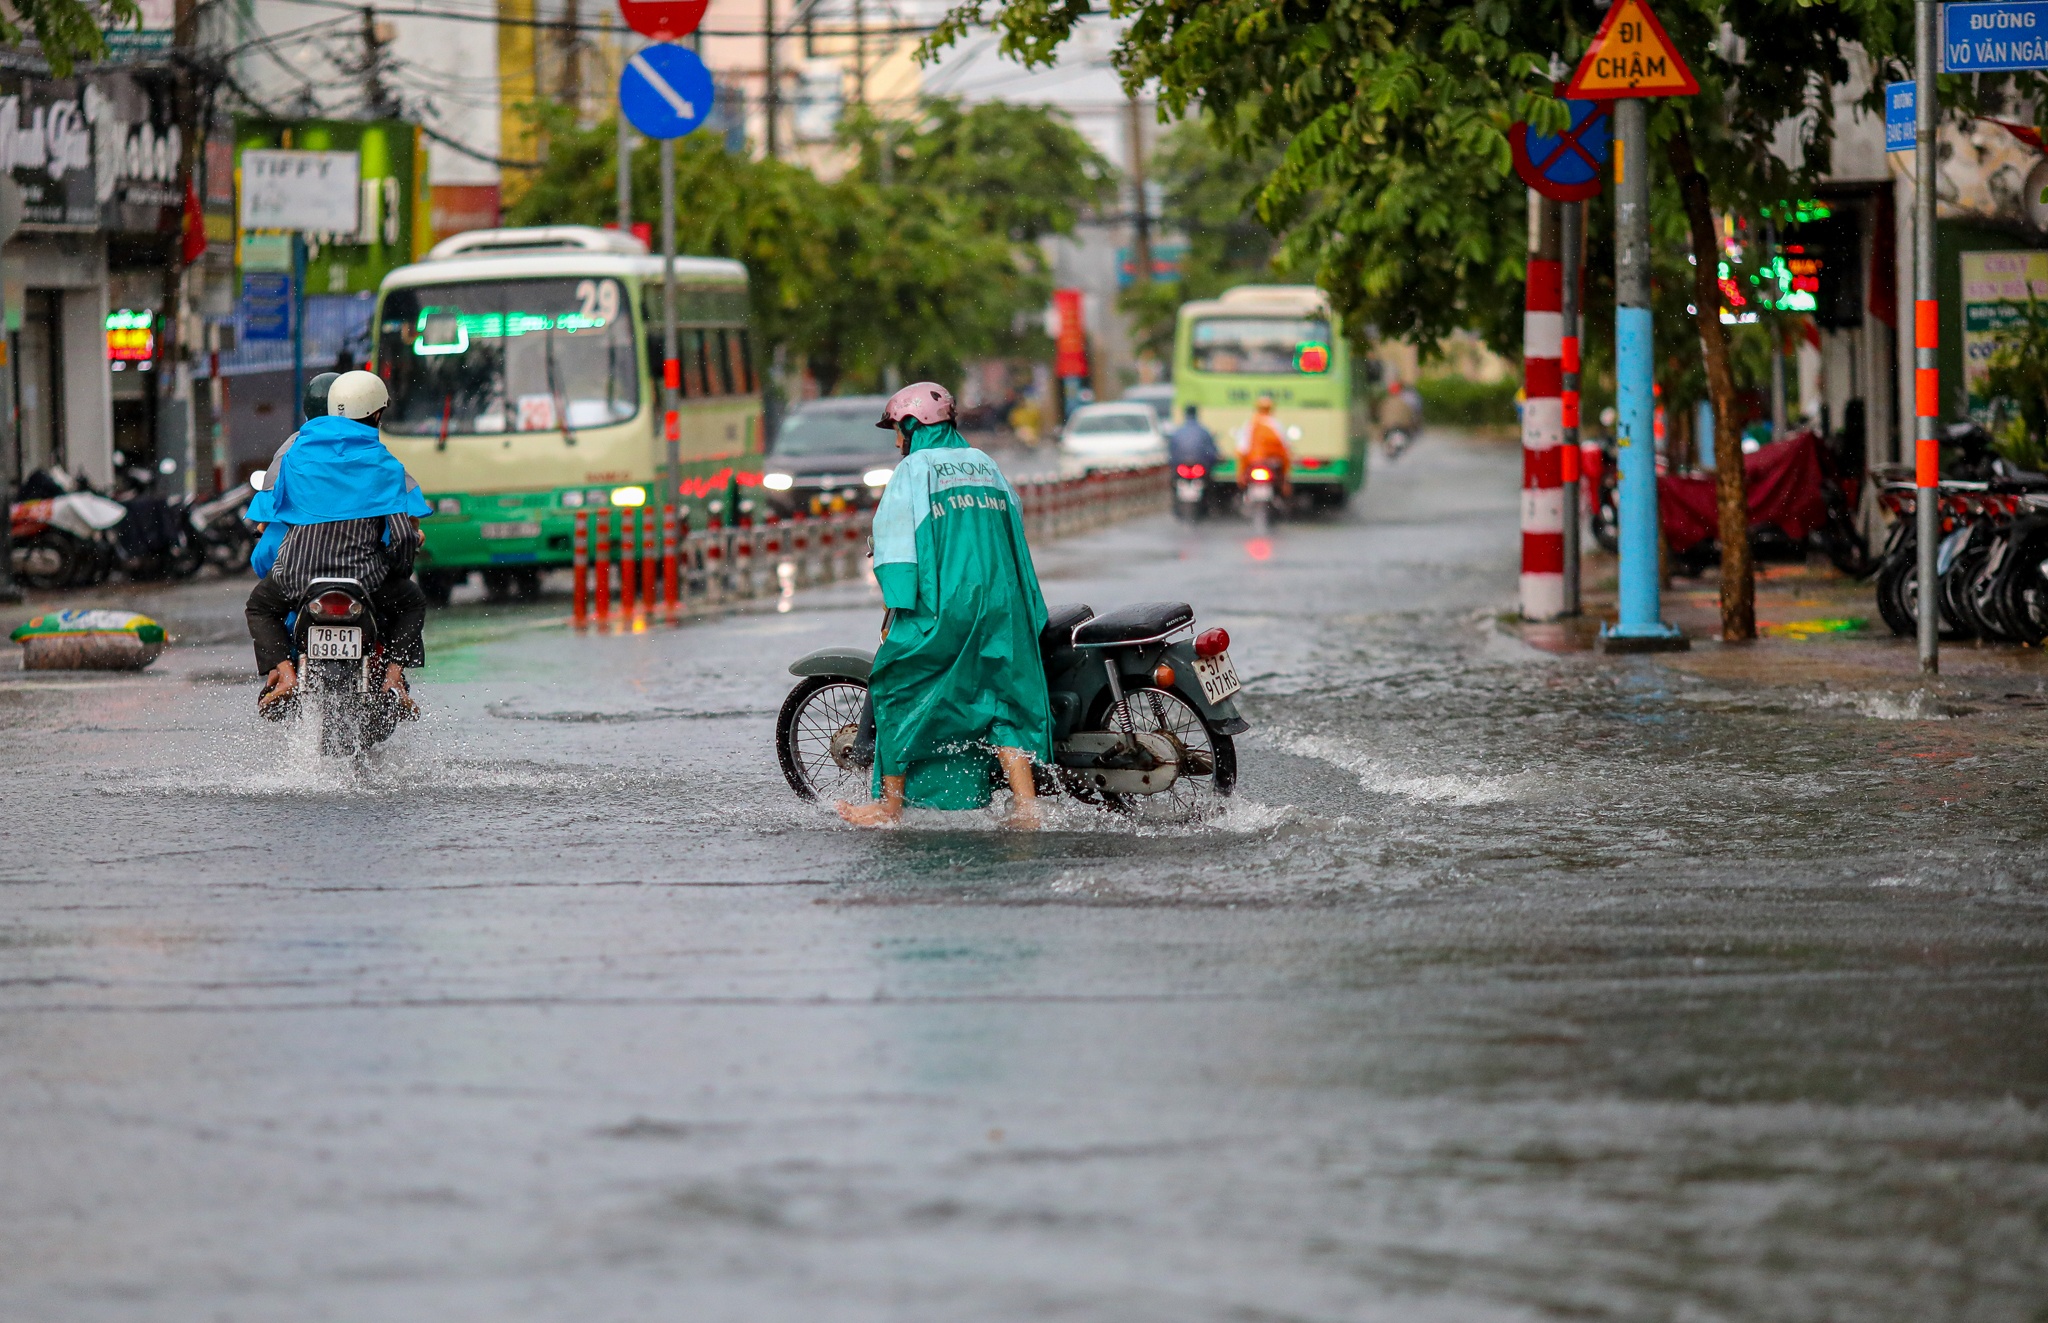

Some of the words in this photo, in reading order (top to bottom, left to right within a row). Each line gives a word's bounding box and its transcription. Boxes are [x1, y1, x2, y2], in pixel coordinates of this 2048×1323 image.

[1970, 10, 2036, 30] ĐƯỜNG
[1618, 21, 1643, 43] ĐI
[1950, 39, 1971, 64] VÕ
[1975, 37, 2007, 63] VĂN
[1596, 52, 1666, 83] CHẬM
[576, 279, 620, 325] 29
[933, 462, 992, 478] RENOVA
[931, 501, 946, 520] ÁI
[948, 494, 975, 511] TẠO
[1165, 614, 1188, 627] HONDA
[317, 629, 354, 643] 78-G1
[1205, 656, 1219, 676] 57
